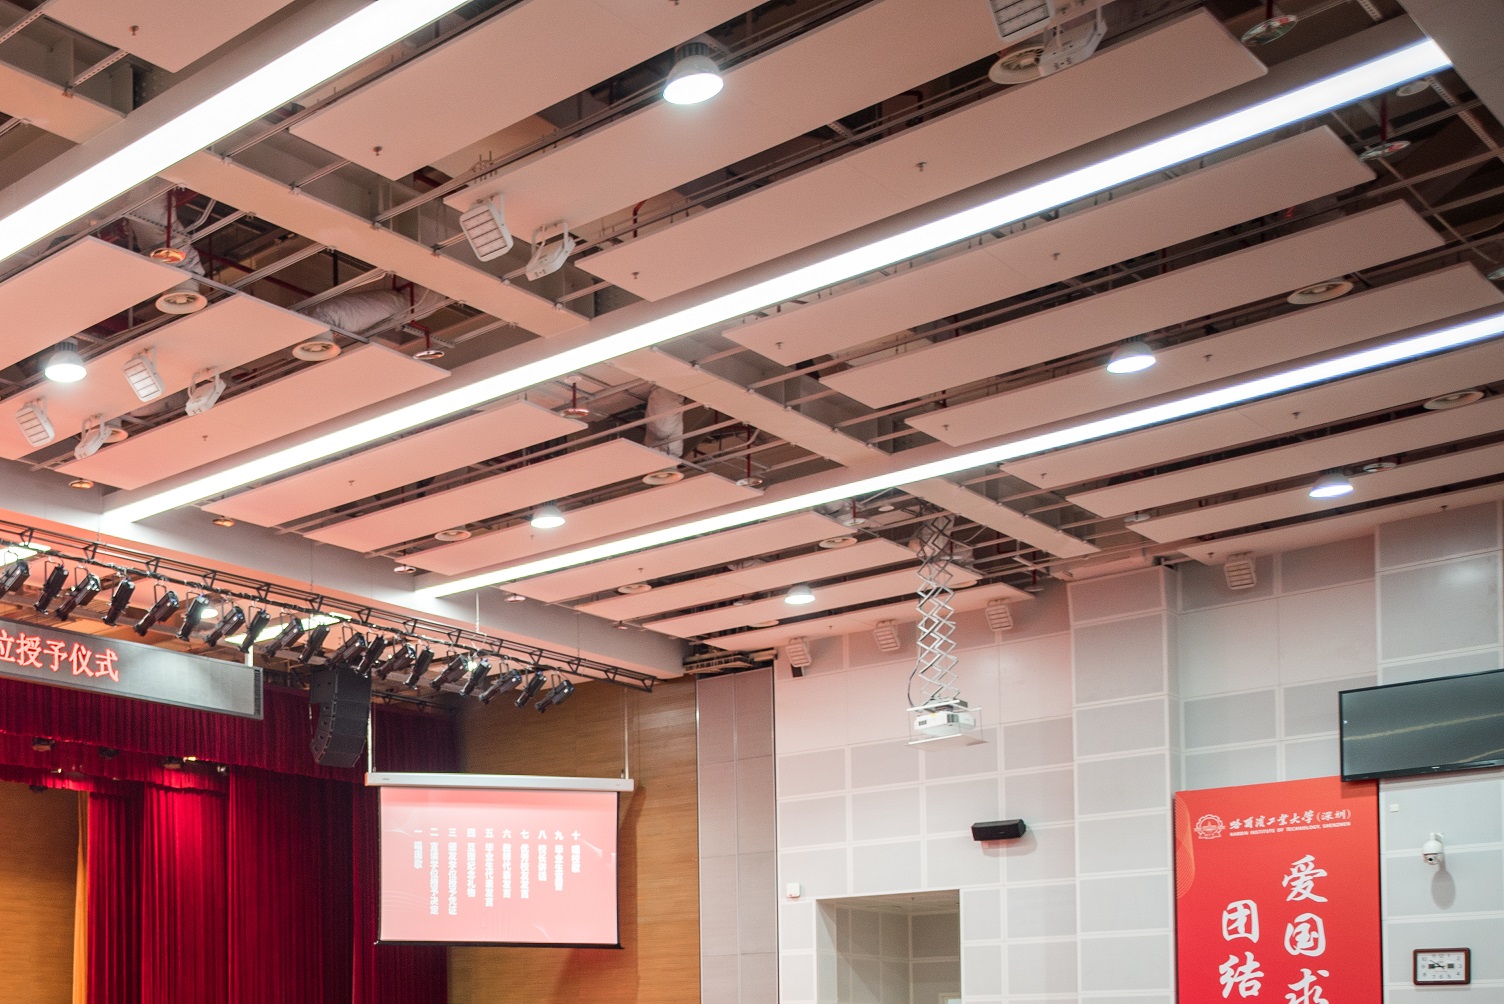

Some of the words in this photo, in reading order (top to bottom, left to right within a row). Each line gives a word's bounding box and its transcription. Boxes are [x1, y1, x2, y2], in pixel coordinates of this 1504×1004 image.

[429, 827, 439, 837] 二
[448, 828, 457, 837] 三
[467, 828, 476, 838] 四
[484, 828, 494, 838] 五
[502, 829, 512, 839] 六
[520, 829, 530, 839] 七
[538, 830, 548, 840] 八
[554, 830, 564, 840] 九
[571, 830, 581, 840] 十
